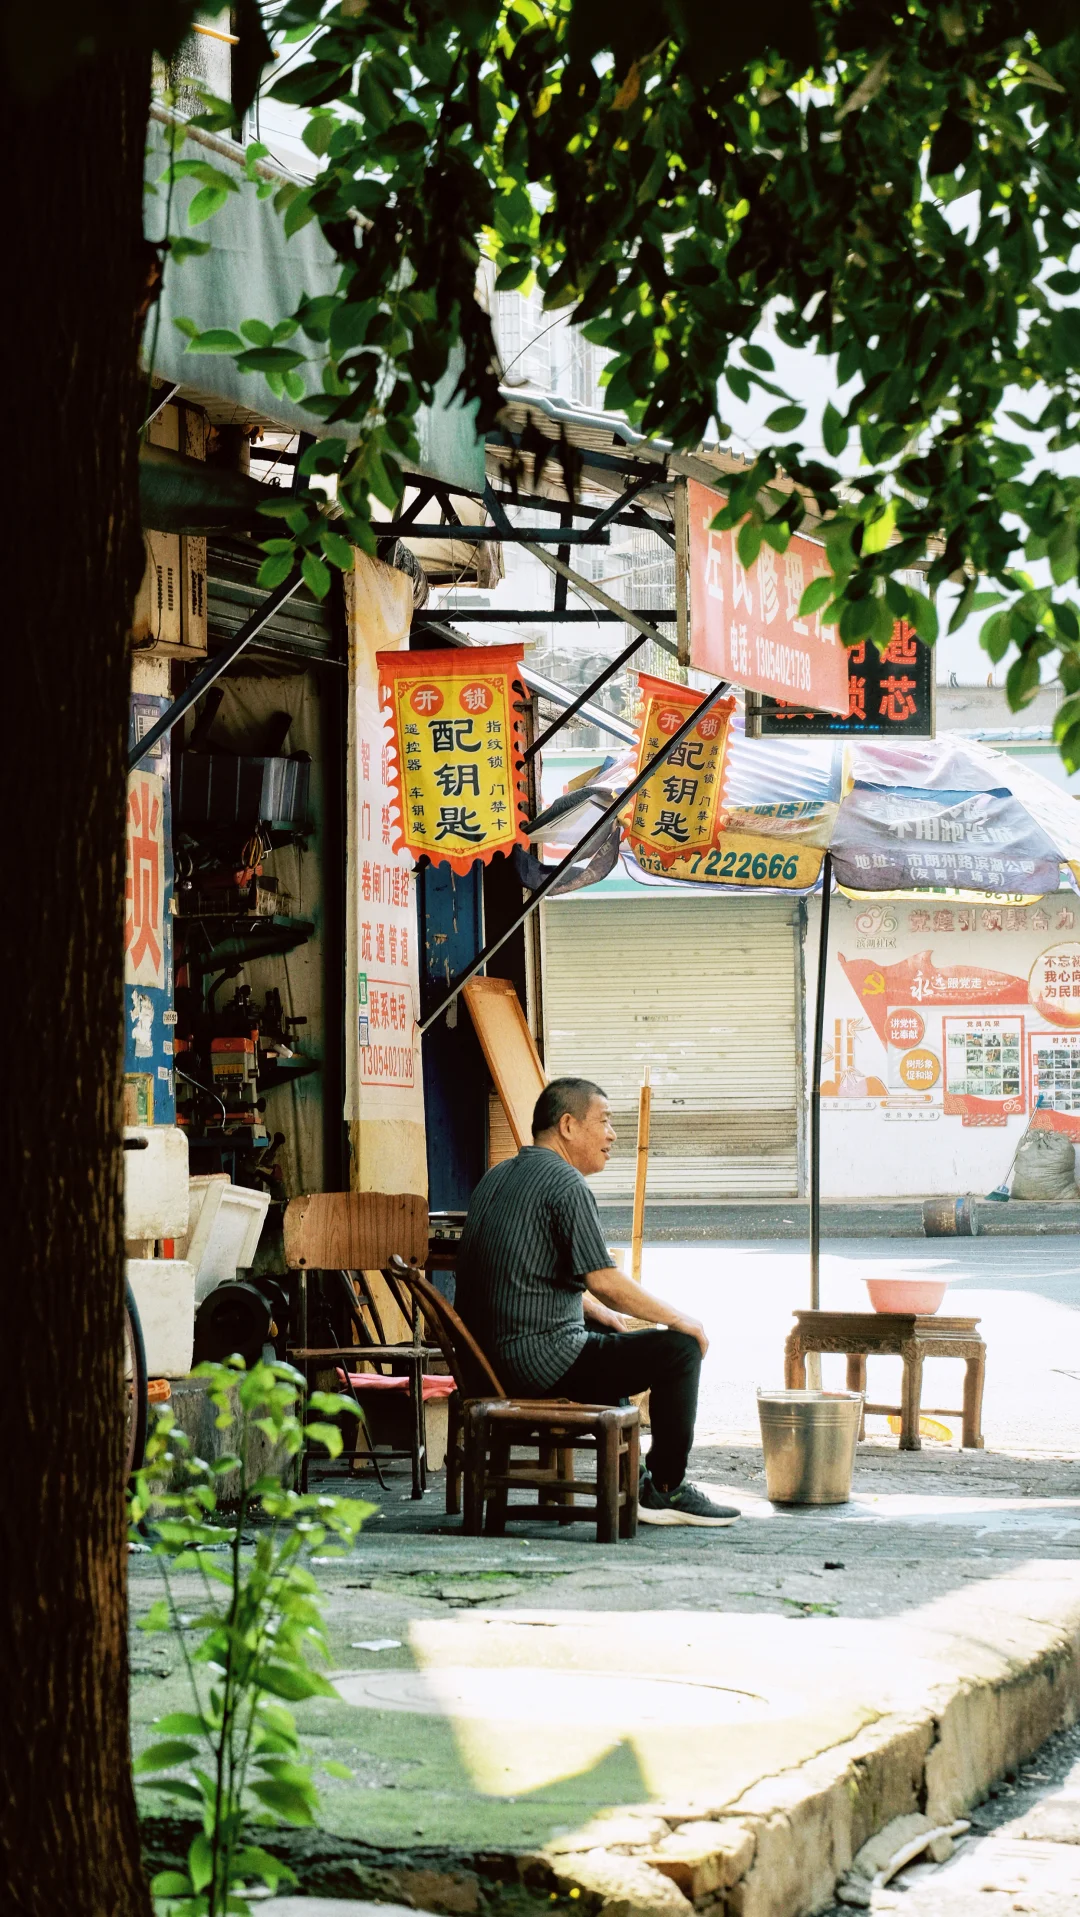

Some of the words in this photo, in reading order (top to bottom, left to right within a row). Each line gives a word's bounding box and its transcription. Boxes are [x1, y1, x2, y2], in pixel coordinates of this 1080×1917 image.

[848, 618, 917, 665] 匙
[414, 689, 488, 711] 开锁
[486, 720, 504, 769] 指纹锁
[660, 713, 718, 737] 开锁
[361, 739, 390, 786] 智能
[404, 723, 423, 771] 遥控器
[428, 718, 487, 842] 配钥匙
[650, 741, 706, 843] 配钥匙
[361, 800, 391, 845] 门禁
[409, 786, 427, 834] 车钥匙
[489, 783, 508, 831] 门禁卡
[635, 788, 651, 828] 车钥匙
[695, 795, 711, 836] 门禁卡
[691, 850, 799, 881] 7222666
[908, 907, 1075, 934] 党建引领聚合力
[361, 921, 409, 967] 疏通管道
[910, 970, 982, 1001] 永远跟党走
[369, 990, 407, 1031] 联系电话
[890, 1018, 918, 1028] 讲党性
[891, 1029, 918, 1040] 比奉献
[1052, 1036, 1080, 1045] 时光印
[361, 1043, 413, 1078] 13054021738
[906, 1059, 934, 1069] 树形象
[906, 1070, 933, 1081] 促和谐
